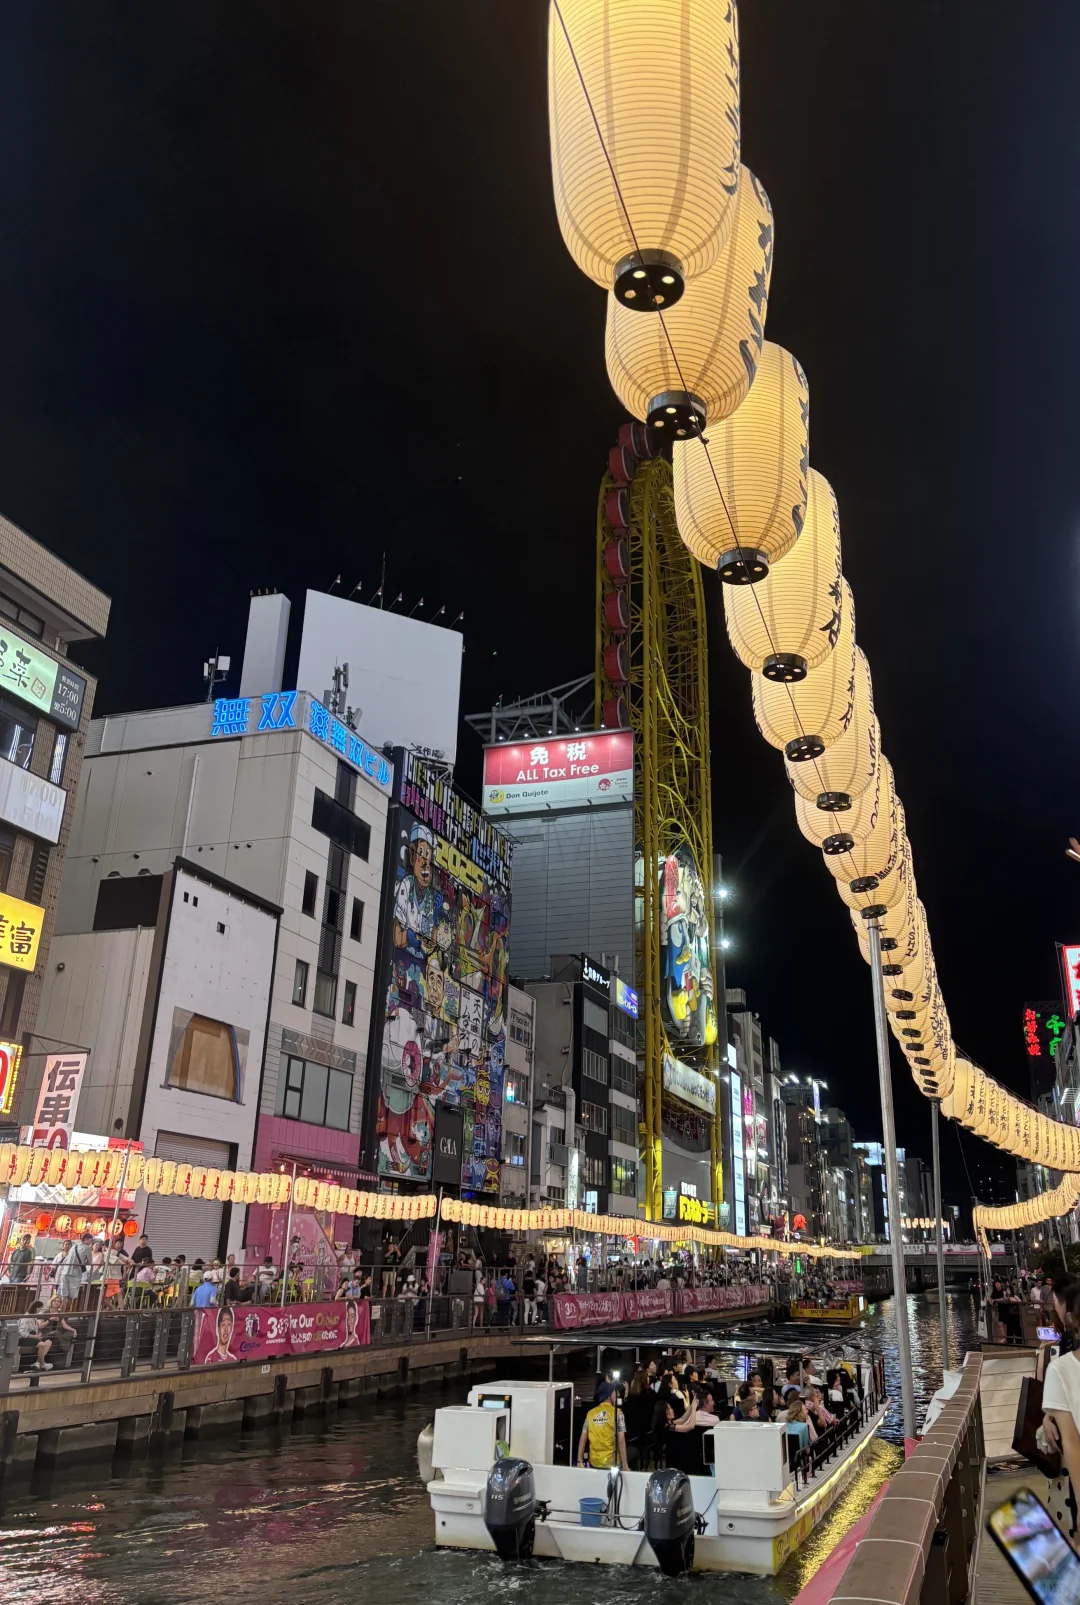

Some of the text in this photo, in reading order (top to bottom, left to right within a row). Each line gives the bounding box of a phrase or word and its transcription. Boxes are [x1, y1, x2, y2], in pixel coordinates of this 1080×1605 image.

[57, 683, 79, 705] 17:00
[211, 690, 299, 736] 無双
[330, 718, 390, 785] 無双ビル
[530, 741, 587, 767] 免税
[516, 764, 600, 782] ALL Tax Free
[506, 789, 549, 799] Don Quijote
[435, 837, 484, 895] 2025
[37, 1060, 81, 1128] 伝串
